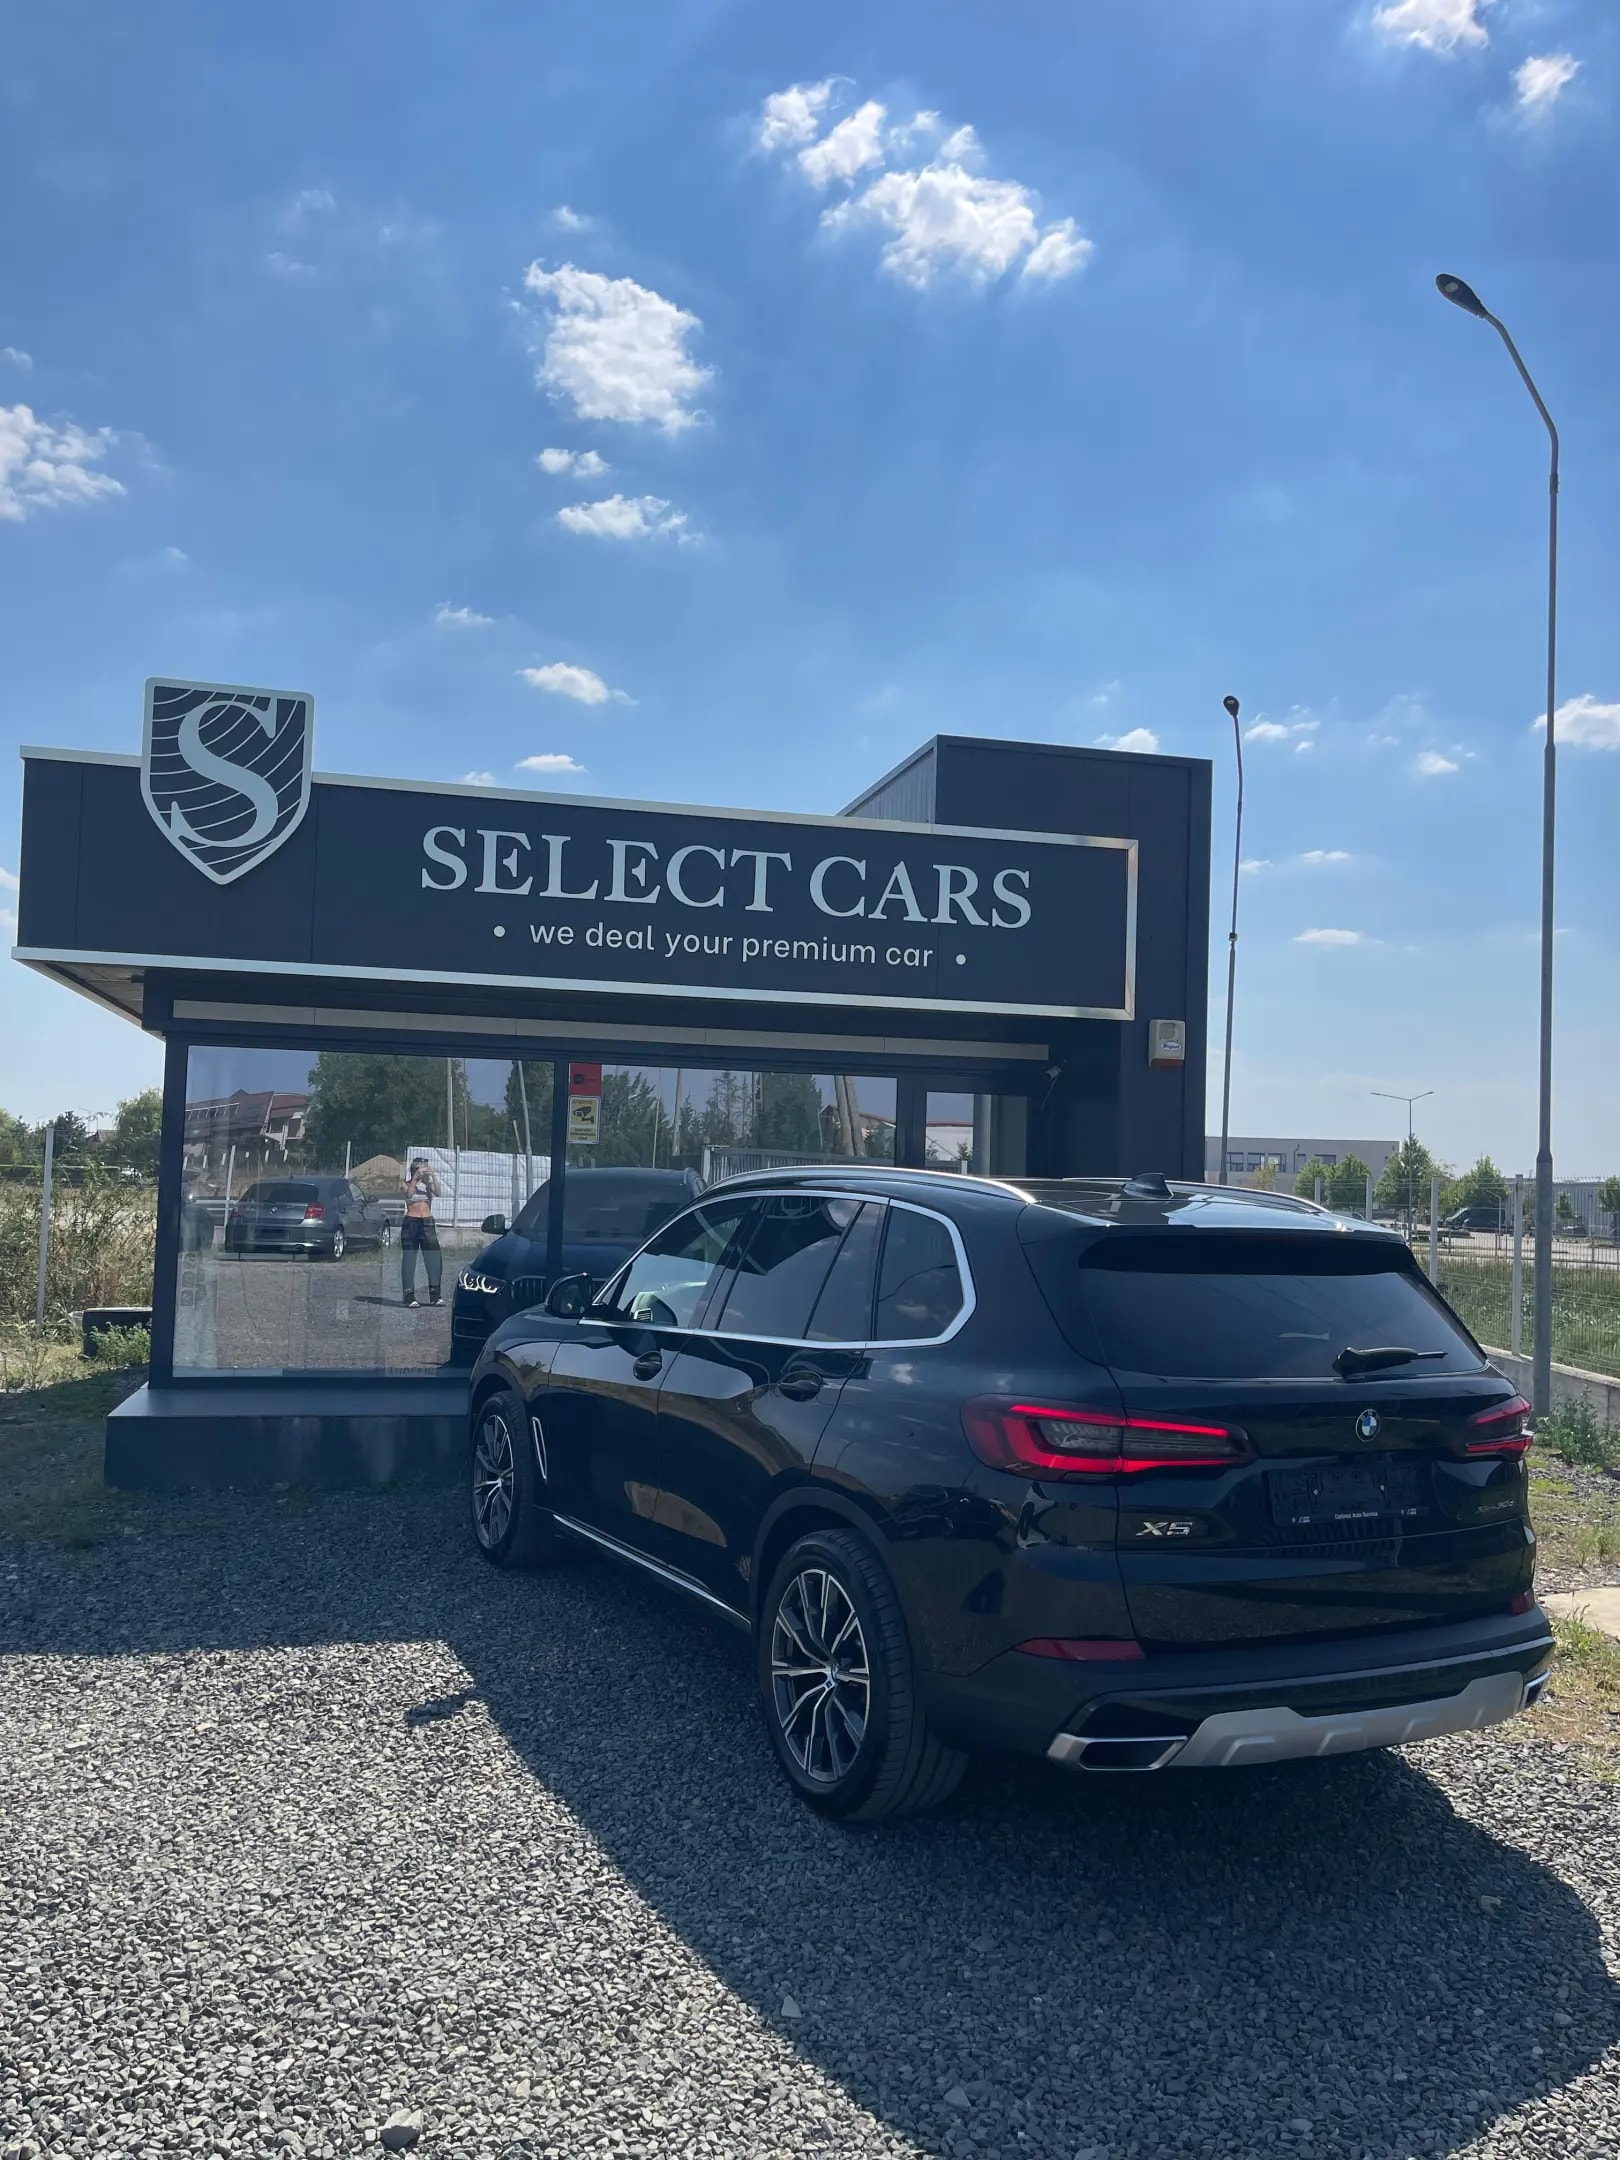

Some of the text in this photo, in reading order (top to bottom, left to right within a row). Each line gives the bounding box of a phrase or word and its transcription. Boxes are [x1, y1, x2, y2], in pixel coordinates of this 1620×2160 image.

[171, 699, 280, 848] S
[420, 825, 1033, 930] SELECT CARS
[529, 922, 935, 969] we deal your premium car
[1135, 1521, 1193, 1536] X5
